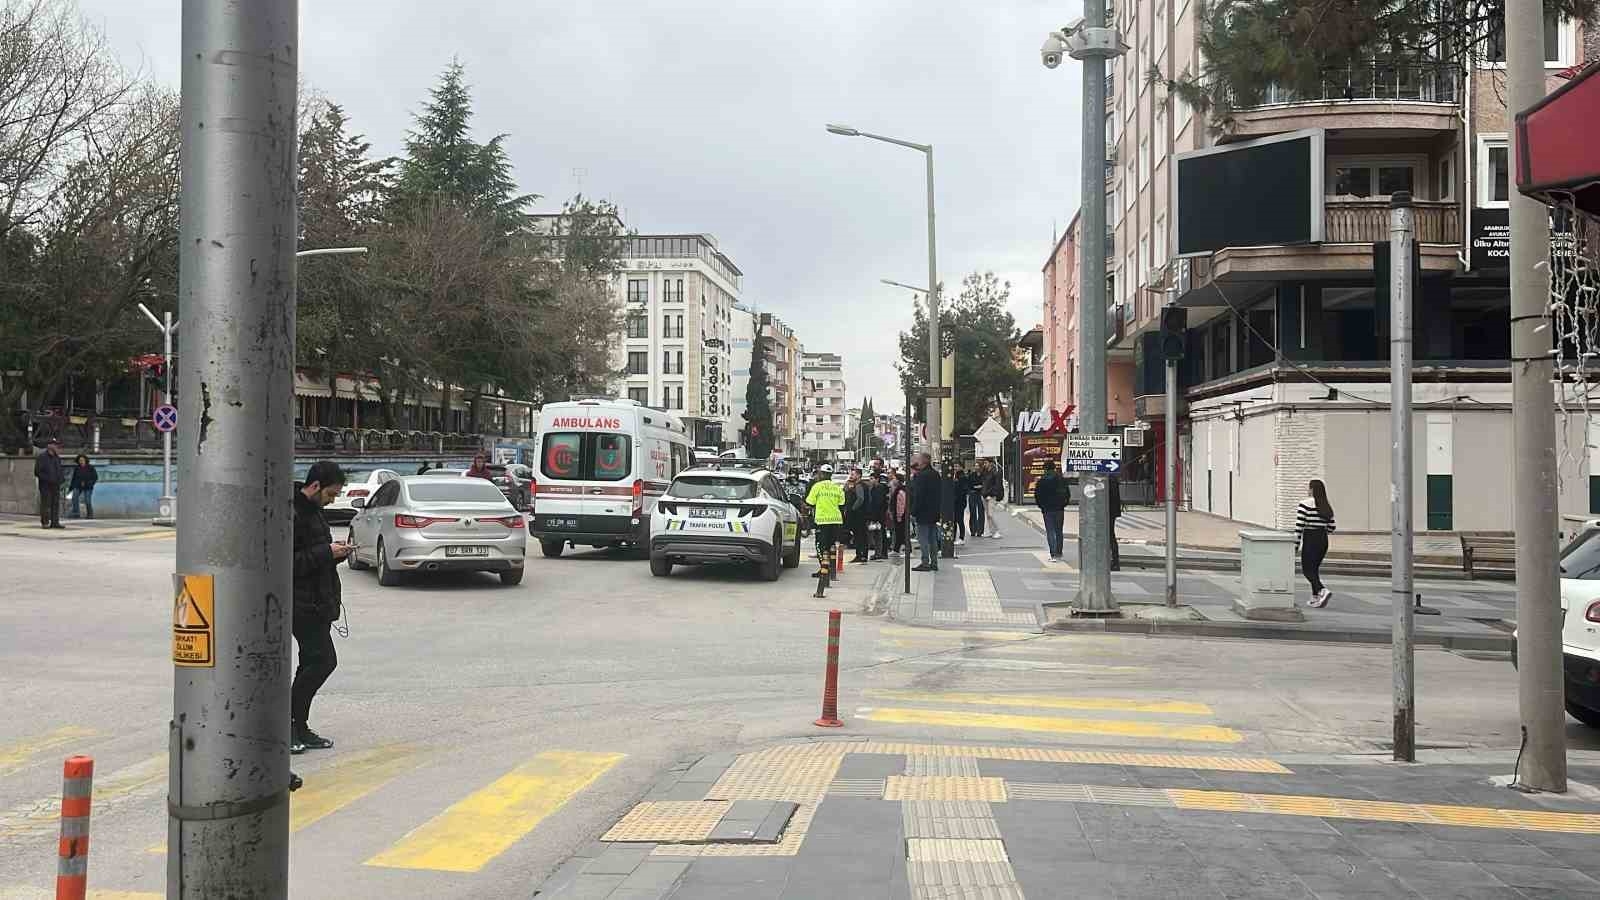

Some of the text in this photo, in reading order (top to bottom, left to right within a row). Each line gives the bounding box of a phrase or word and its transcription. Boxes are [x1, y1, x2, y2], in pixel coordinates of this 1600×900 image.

[1488, 249, 1510, 257] KOCA
[552, 416, 622, 429] AMBULANS
[1069, 448, 1094, 459] MAKÜ
